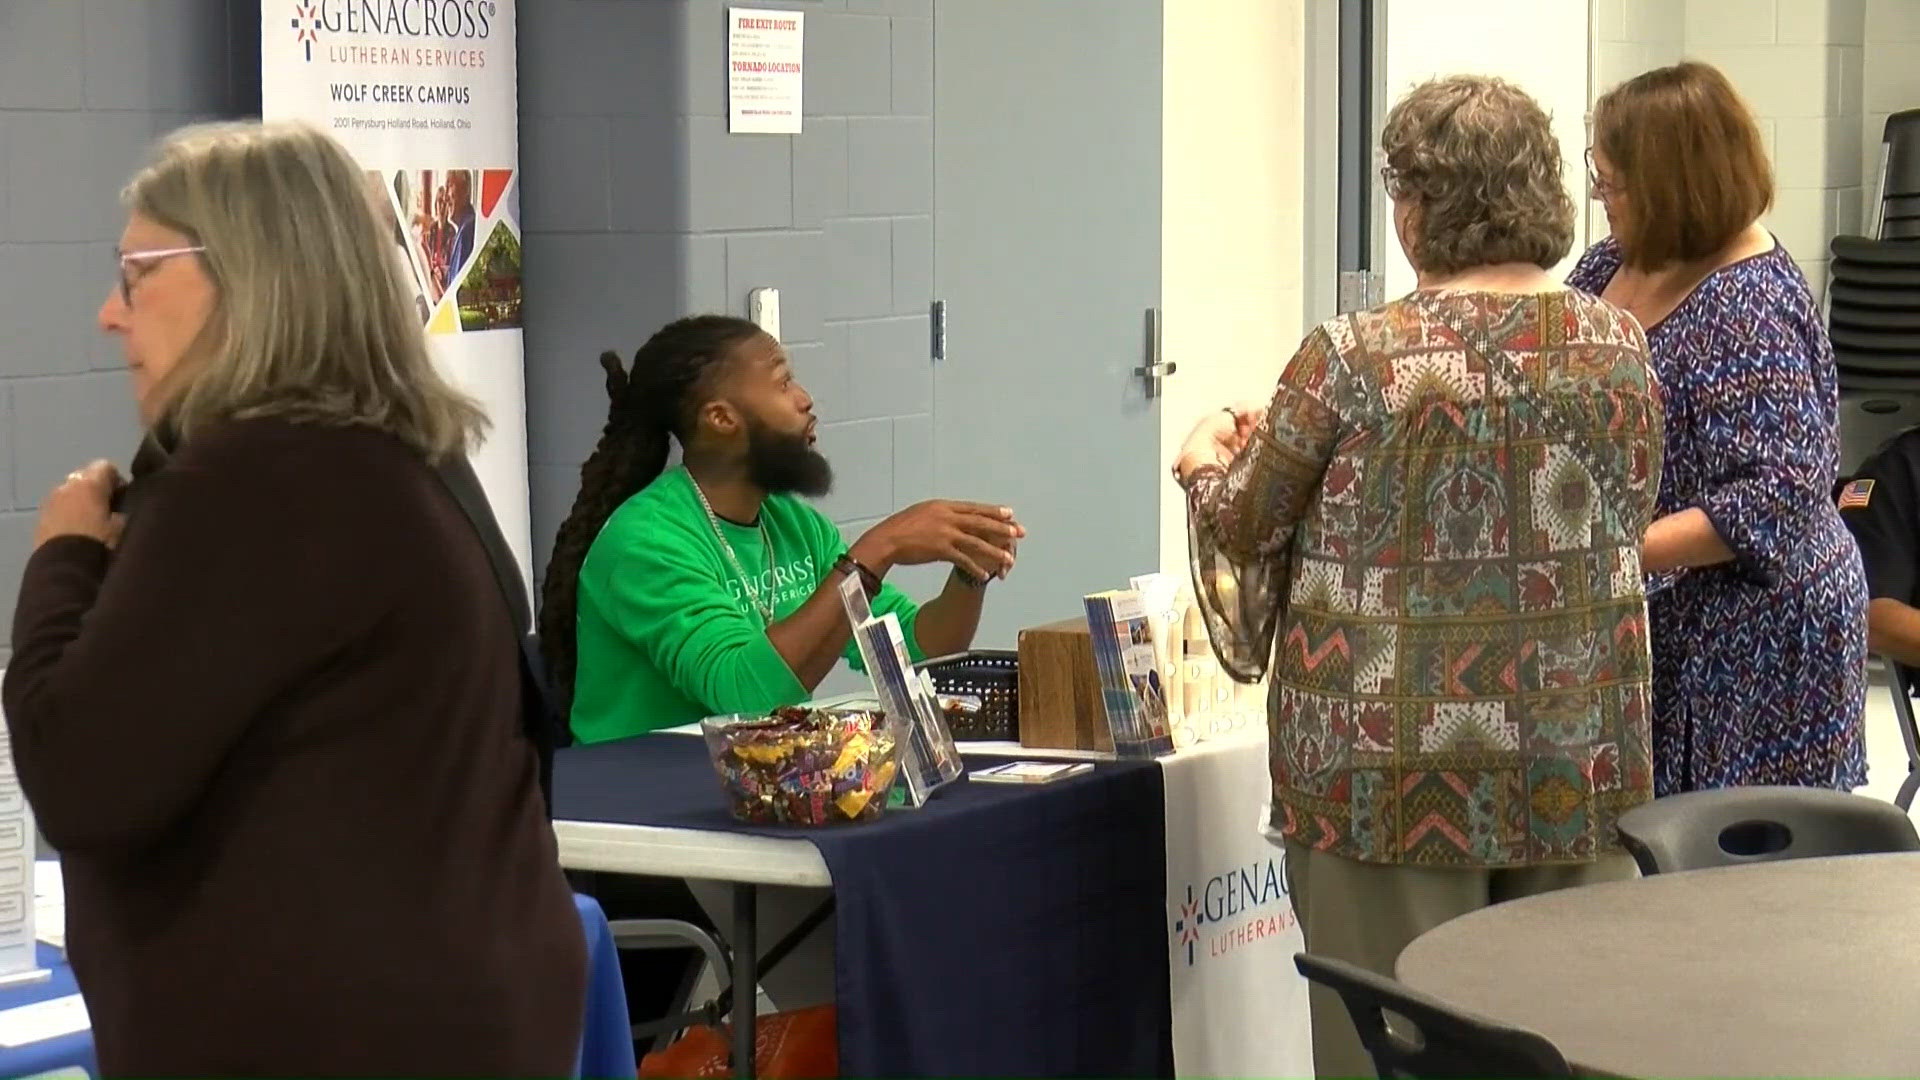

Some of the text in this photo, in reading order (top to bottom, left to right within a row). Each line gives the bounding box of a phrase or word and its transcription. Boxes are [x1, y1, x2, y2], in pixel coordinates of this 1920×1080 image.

[738, 17, 797, 31] FIRE EXIT ROUTE
[329, 45, 486, 68] LUTHERAN SERVICES
[732, 61, 801, 74] TORNADO LOCATION
[330, 83, 471, 105] WOLF CREEK CAMPUS
[333, 116, 351, 129] 2001
[351, 117, 386, 130] Perrysburg
[387, 118, 412, 130] Holland
[457, 118, 472, 131] Ohio
[1211, 912, 1286, 957] LUTHERAN
